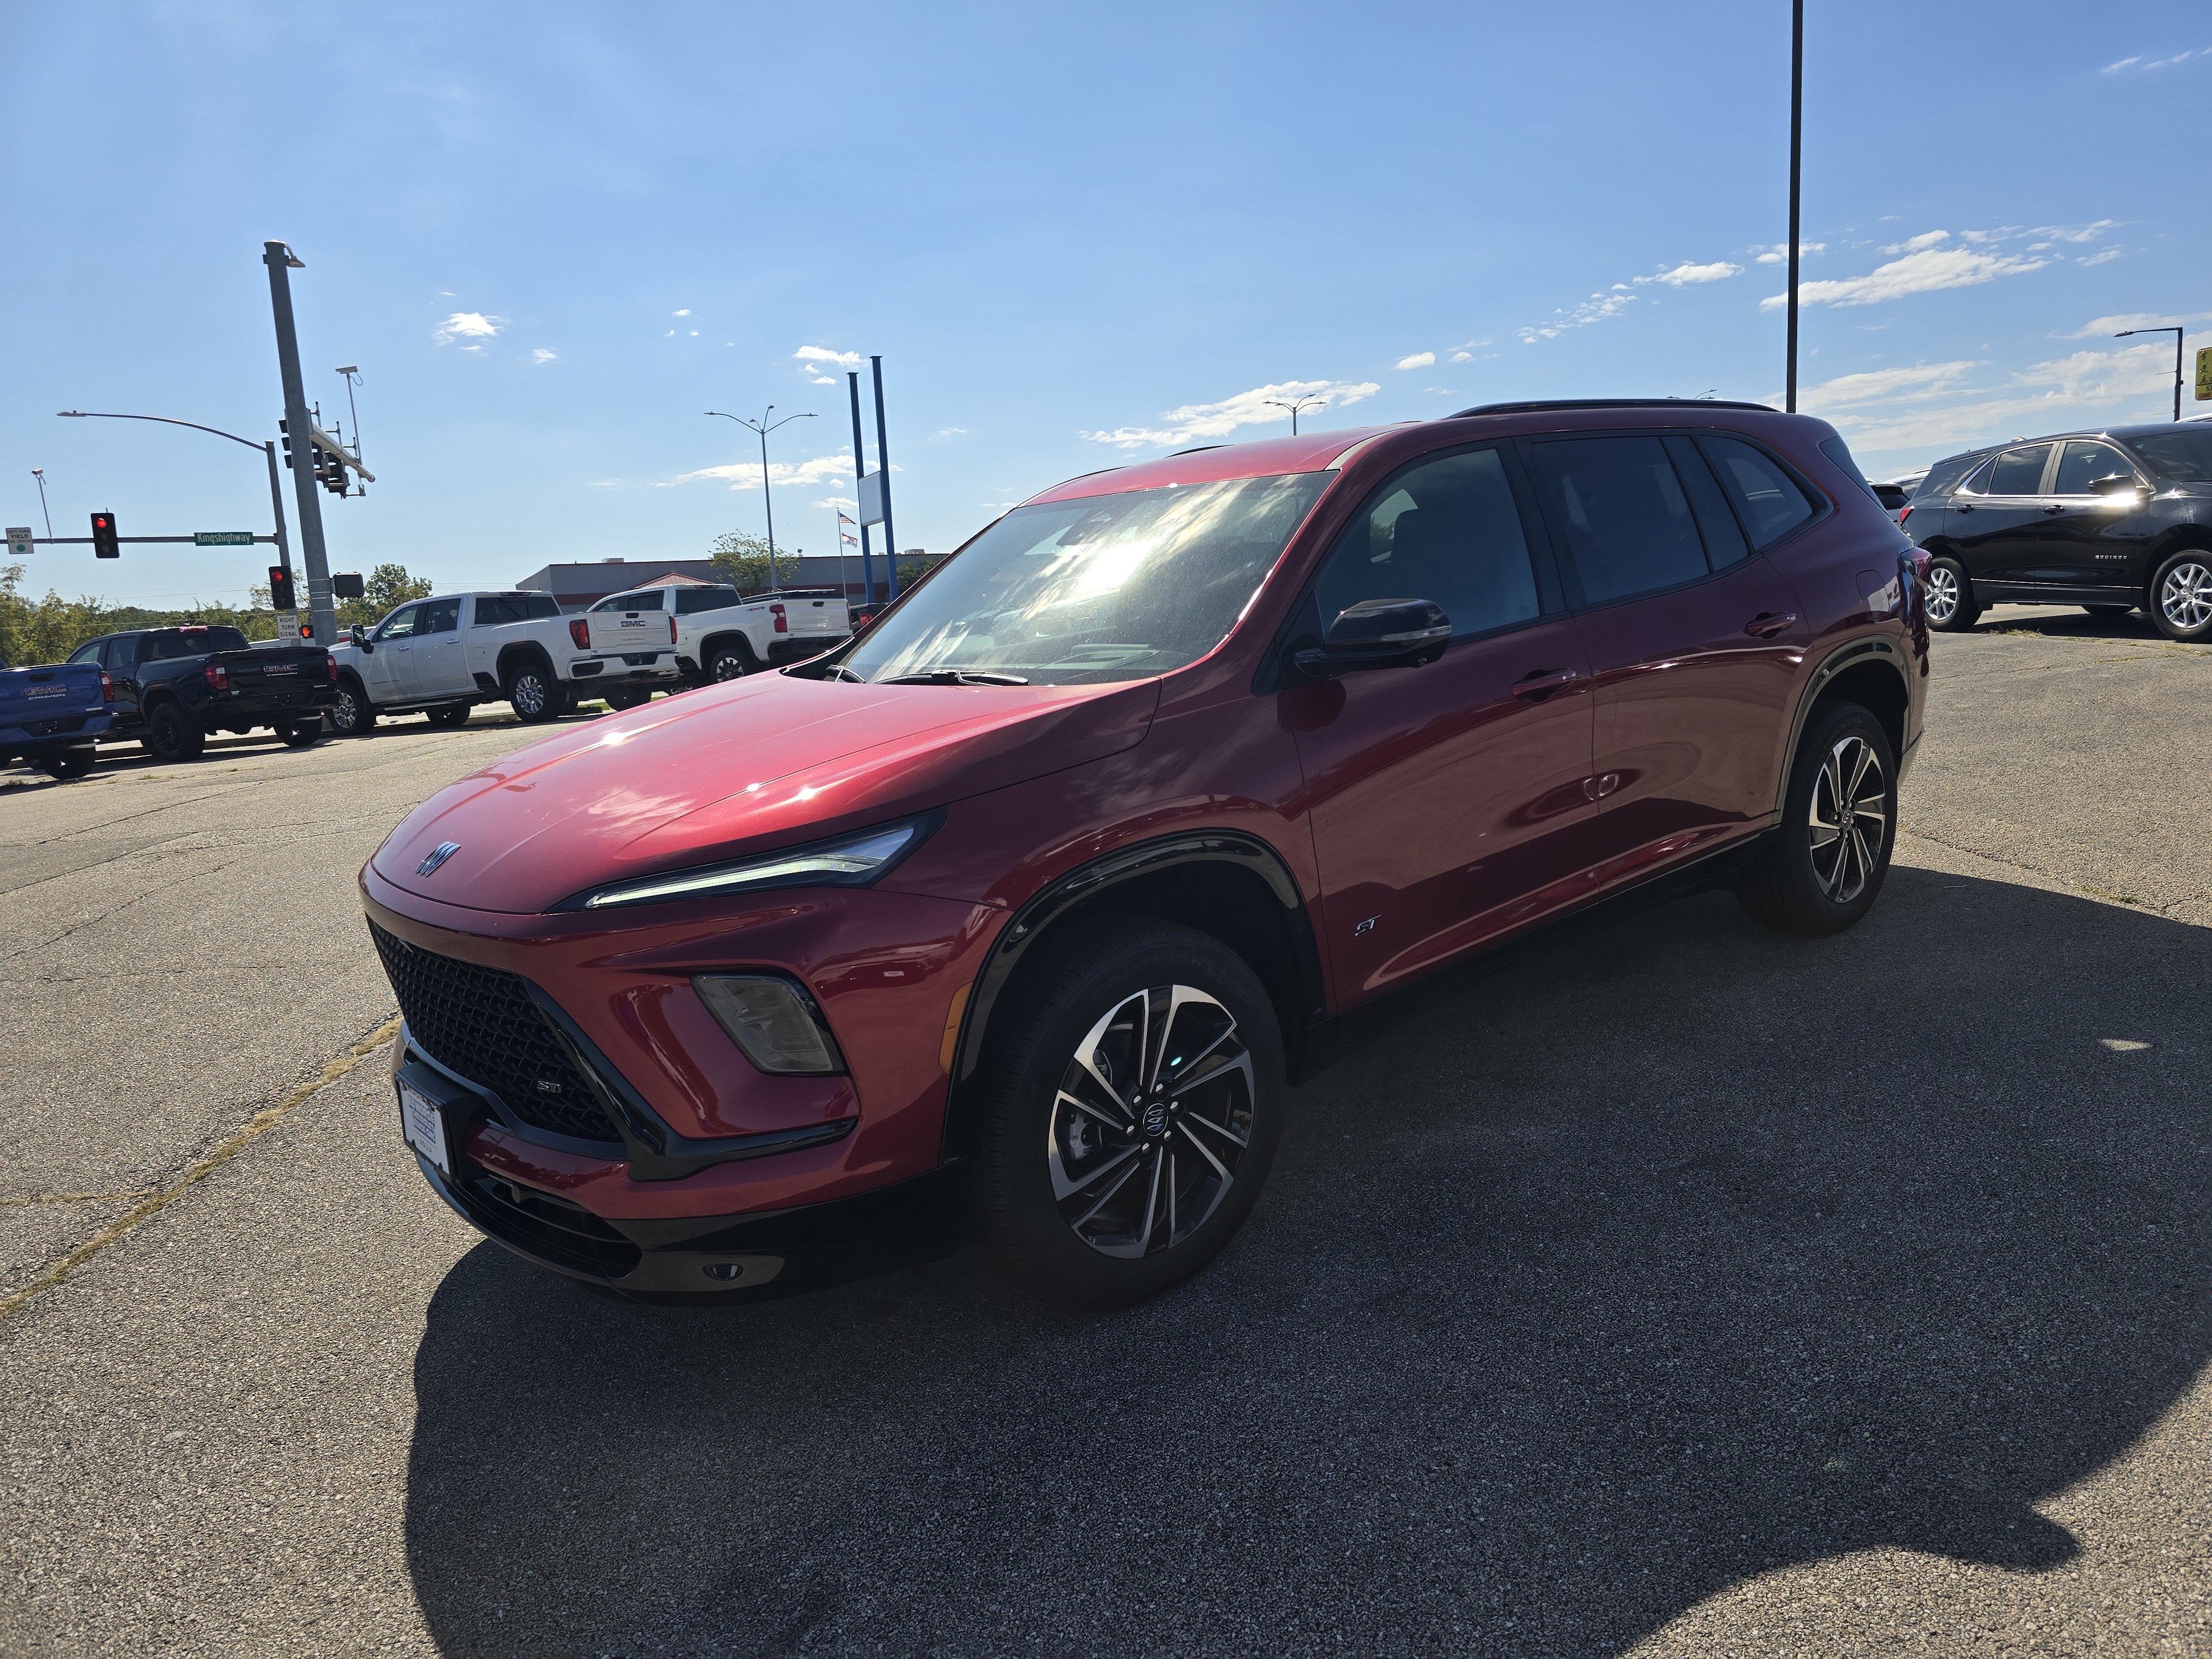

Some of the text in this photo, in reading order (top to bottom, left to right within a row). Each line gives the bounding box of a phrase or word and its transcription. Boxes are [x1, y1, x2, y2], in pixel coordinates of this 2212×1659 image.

[197, 533, 251, 545] Kingshighway
[263, 664, 299, 672] GMC
[24, 684, 67, 696] GMC
[1355, 915, 1381, 936] ST
[537, 1080, 561, 1093] ST
